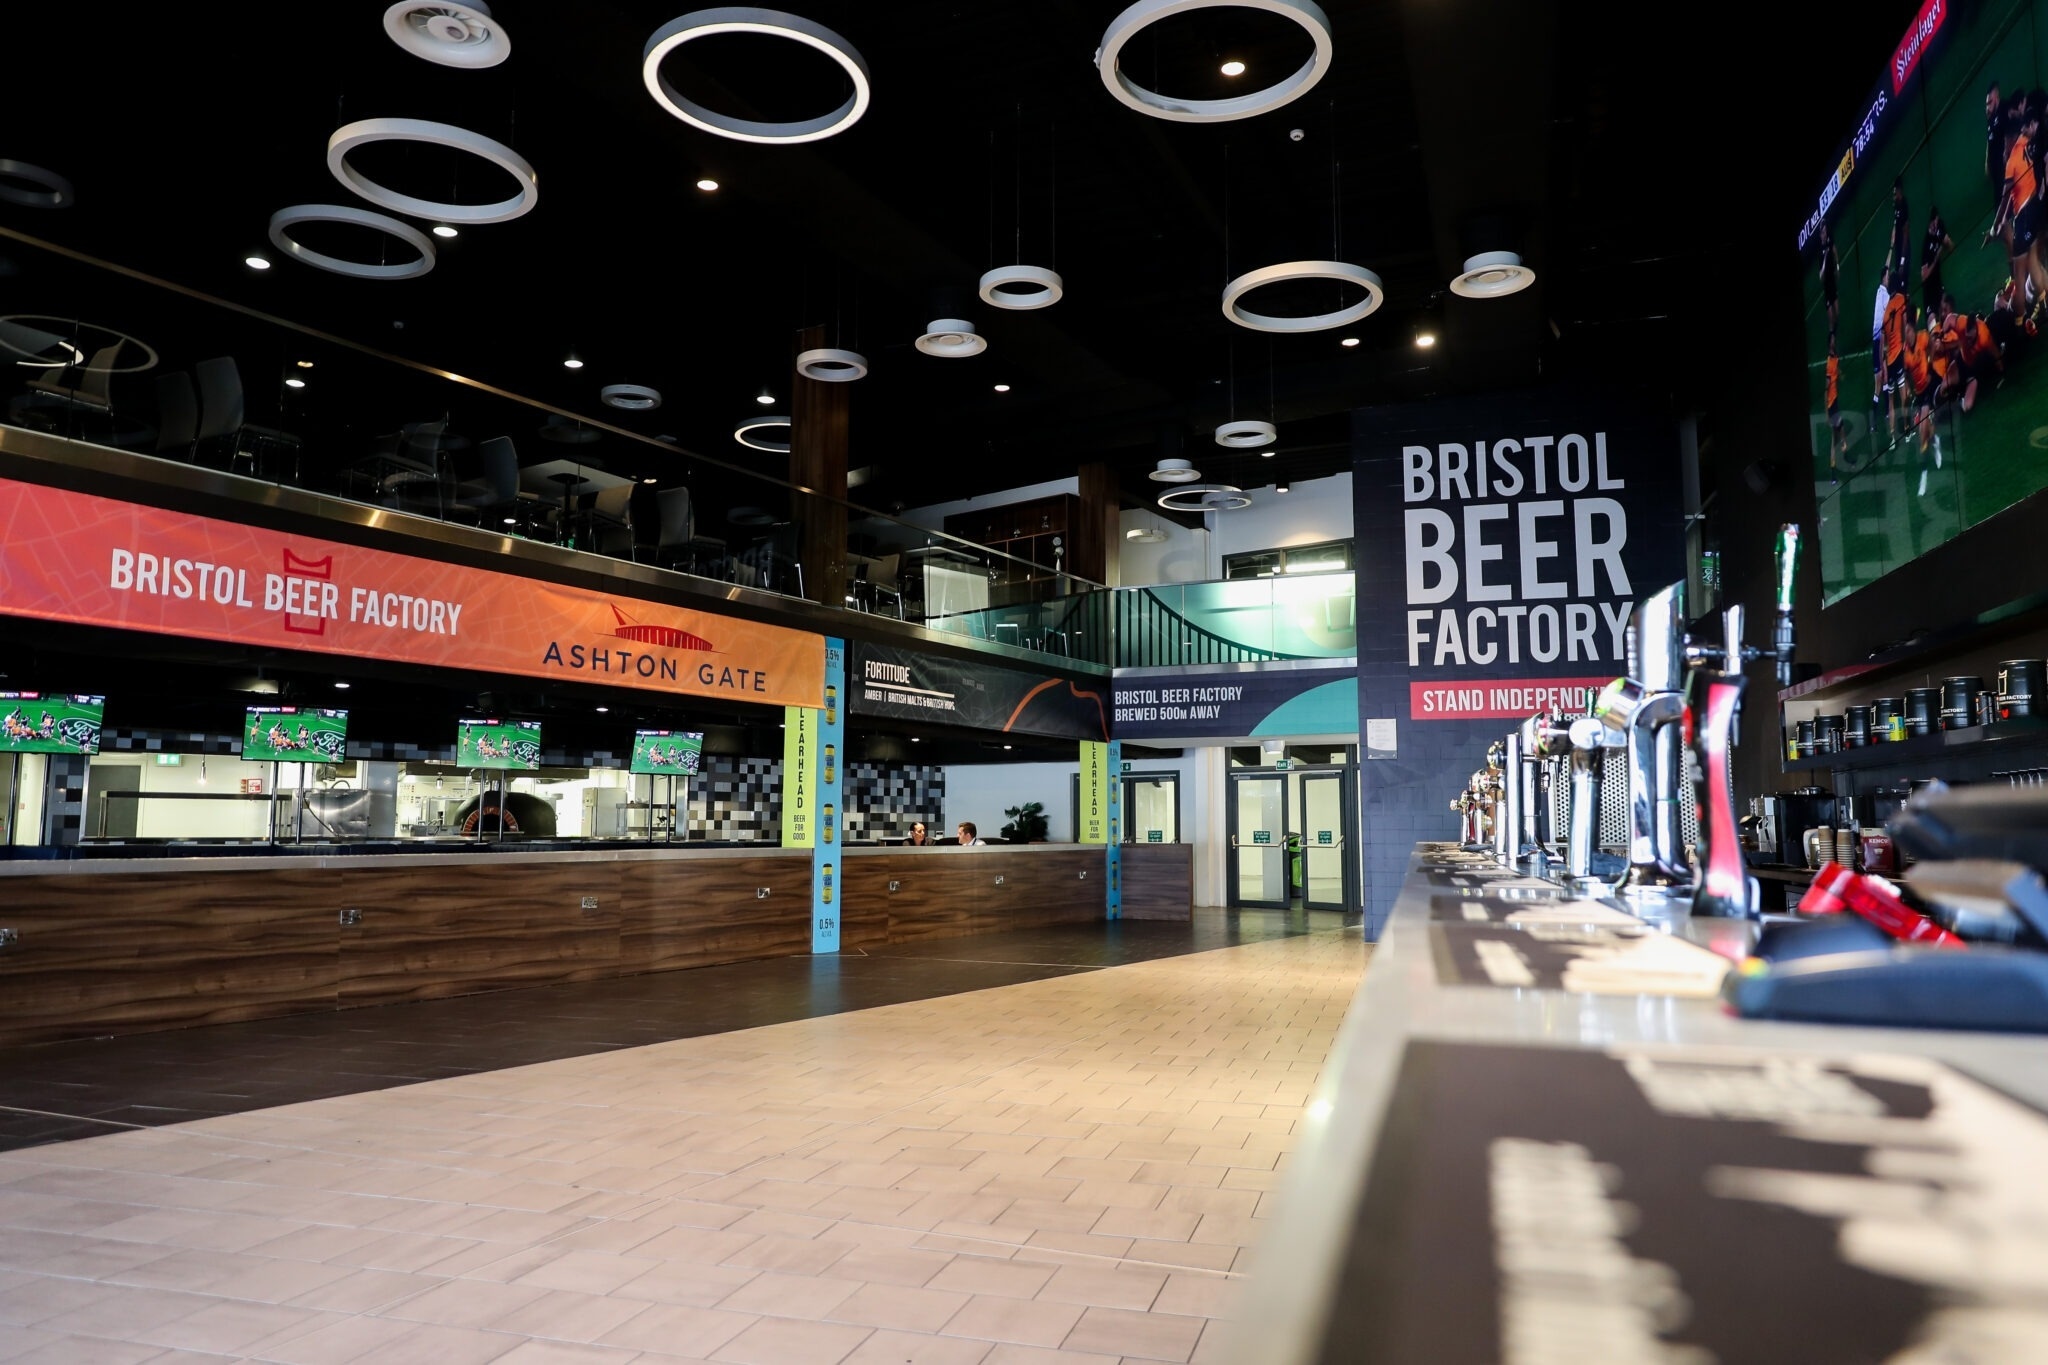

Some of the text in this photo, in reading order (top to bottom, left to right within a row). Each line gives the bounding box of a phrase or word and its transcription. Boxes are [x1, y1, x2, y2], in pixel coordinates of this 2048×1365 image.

[1821, 189, 1829, 211] 33
[1831, 175, 1838, 196] 18
[1402, 432, 1625, 502] BRISTOL
[1404, 497, 1633, 605] BEER
[111, 548, 462, 635] BRISTOL BEER FACTORY
[1407, 601, 1634, 667] FACTORY
[542, 641, 766, 692] ASHTON GATE
[865, 660, 911, 684] FORTITUDE
[864, 689, 882, 701] AMBER
[888, 692, 907, 704] BRITISH
[907, 694, 923, 706] MALTS
[927, 697, 944, 710] BRITISH
[1114, 686, 1243, 705] BRISTOL BEER FACTORY
[1423, 686, 1603, 712] STAND INDEPEND
[1114, 707, 1157, 722] BREWED
[1189, 705, 1220, 719] AWAY
[819, 918, 834, 930] 0.5%
